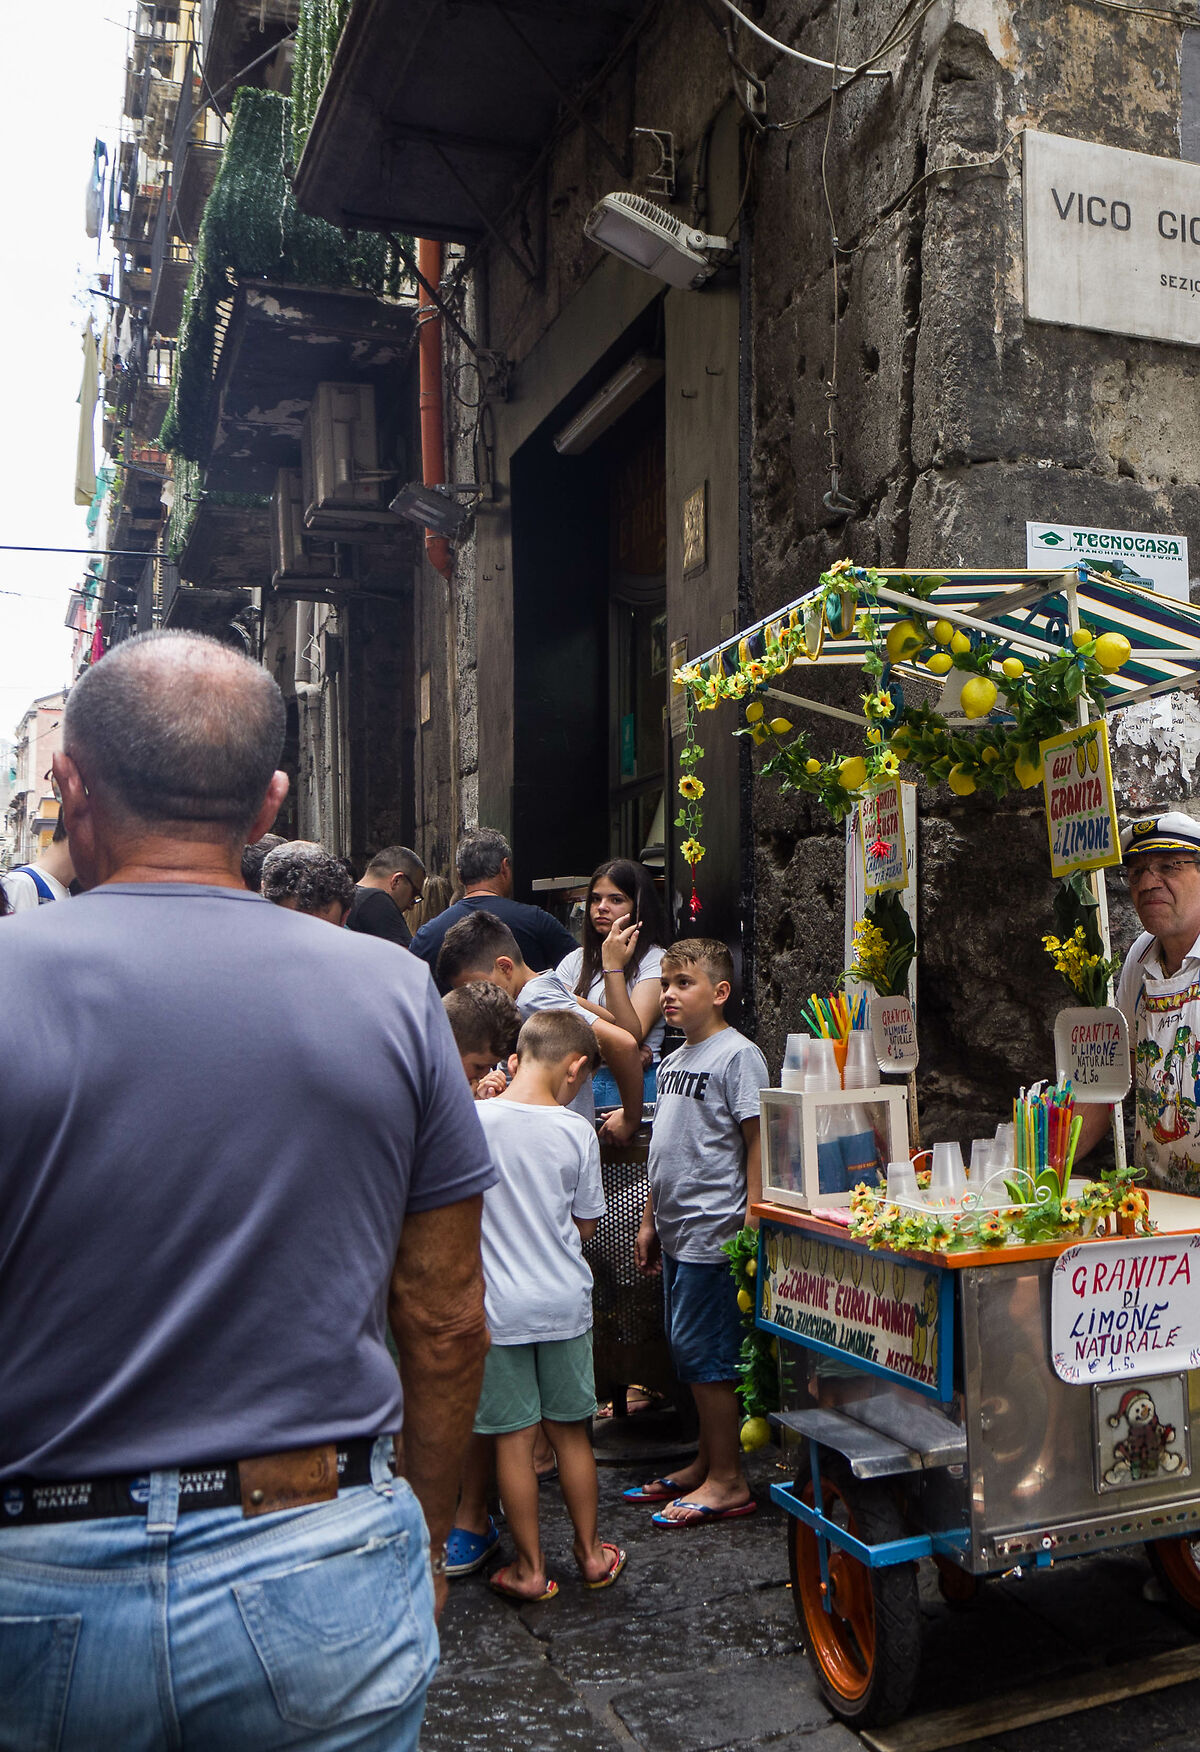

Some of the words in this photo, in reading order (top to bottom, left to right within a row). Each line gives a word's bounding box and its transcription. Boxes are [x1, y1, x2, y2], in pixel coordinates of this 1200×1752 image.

[1050, 188, 1131, 231] VICO
[1072, 532, 1180, 555] TECNOCASA
[1073, 547, 1136, 558] FRANCHISING
[1140, 554, 1183, 562] NETWORK
[1051, 777, 1103, 821] GRANITA
[1062, 815, 1111, 857] LIMONE
[1077, 1055, 1115, 1068] NATURALE
[658, 1070, 710, 1101] RTNITE
[1072, 1252, 1191, 1299] GRANITA
[834, 1284, 916, 1339] EUROLIMONATA
[1123, 1288, 1140, 1308] DI
[1070, 1301, 1169, 1339] LIMONE
[1075, 1326, 1183, 1361] NATURALE
[32, 1482, 92, 1498] NORTH
[179, 1469, 227, 1484] ORTH
[36, 1494, 89, 1509] SAILS
